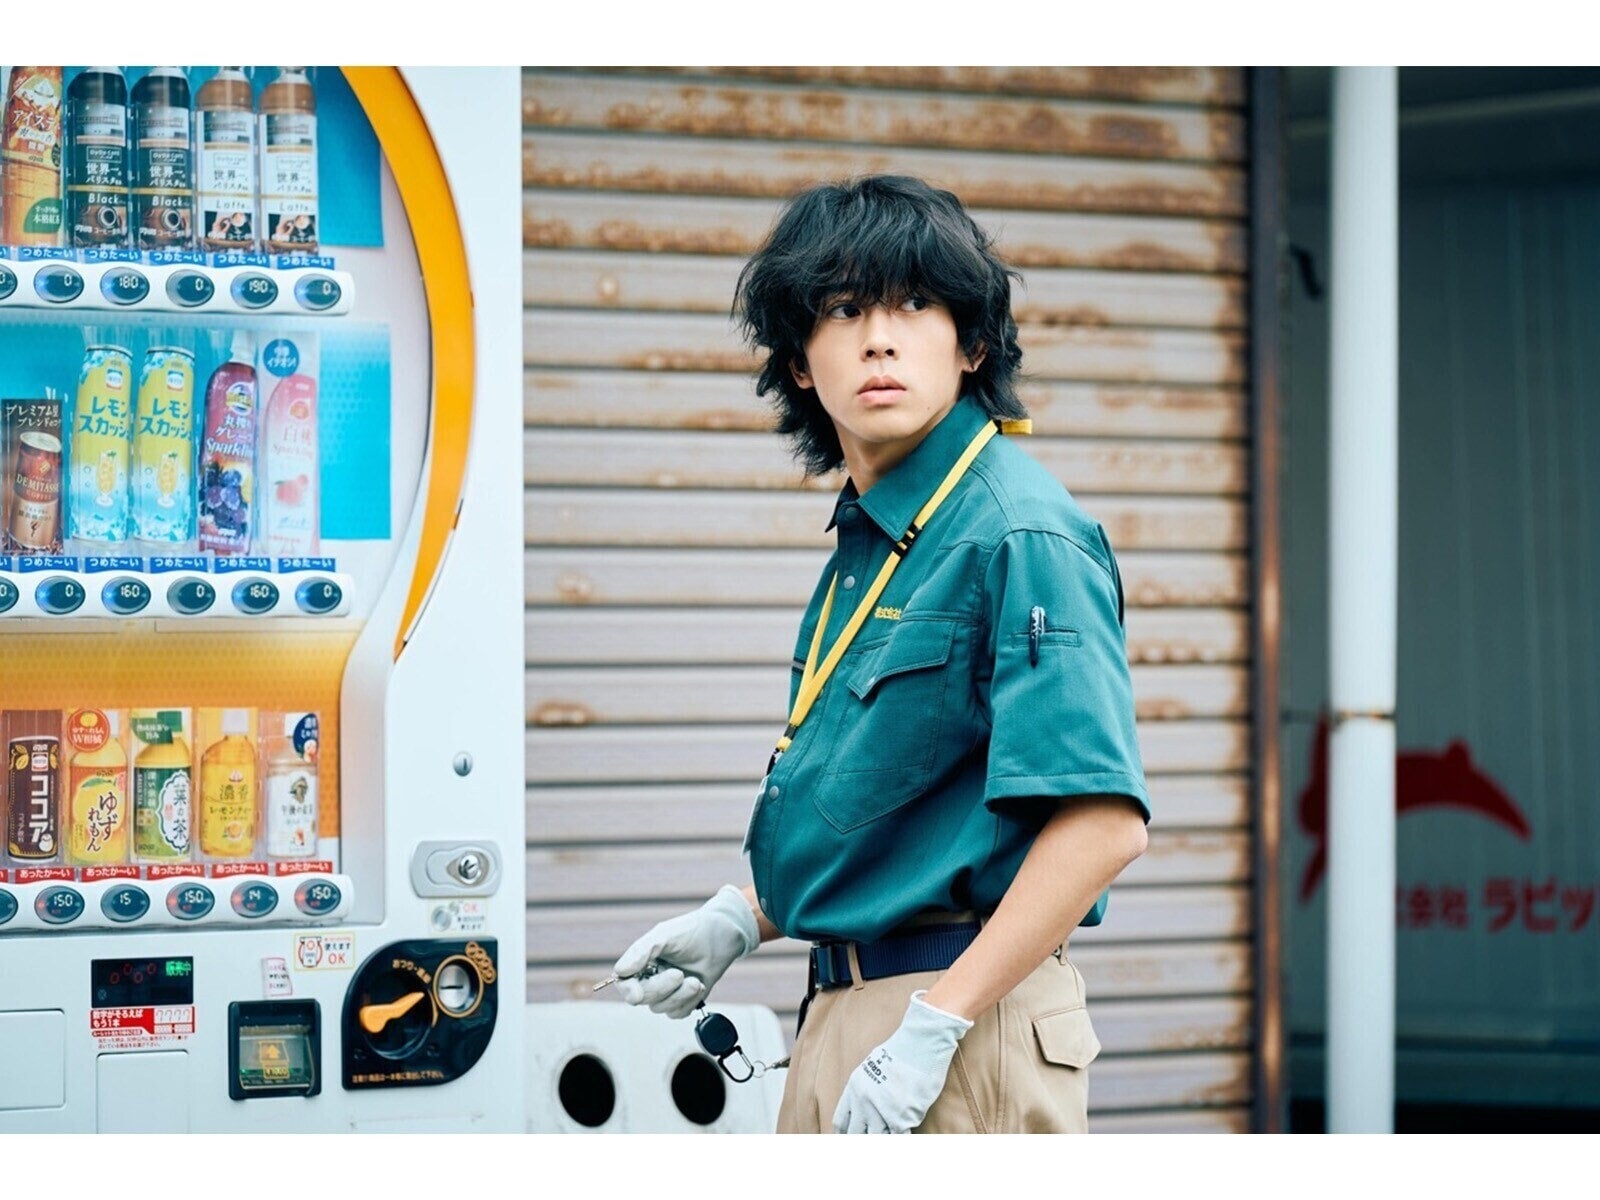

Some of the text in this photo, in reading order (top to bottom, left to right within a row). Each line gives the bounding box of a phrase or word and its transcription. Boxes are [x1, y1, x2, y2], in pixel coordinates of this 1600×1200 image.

[88, 193, 119, 204] Black
[152, 196, 182, 206] Black
[216, 201, 245, 209] Latte
[280, 203, 308, 212] Latte
[23, 249, 74, 258] つめた〜い
[89, 250, 139, 260] つめた〜い
[154, 252, 203, 263] つめた〜い
[217, 254, 267, 265] つめた〜い
[281, 257, 332, 267] つめた〜い
[64, 273, 72, 287] 0
[119, 276, 139, 289] 180
[195, 278, 204, 291] 0
[249, 280, 269, 293] 190
[322, 282, 332, 295] 0
[92, 396, 127, 419] レモン
[153, 398, 189, 420] レモン
[24, 557, 74, 567] つめた〜い
[89, 557, 139, 567] つめた〜い
[155, 557, 204, 567] つめた〜い
[218, 557, 268, 568] つめた〜い
[282, 557, 332, 568] つめた〜い
[65, 584, 74, 597] 0
[120, 584, 140, 598] 160
[196, 584, 205, 598] 0
[250, 585, 270, 598] 160
[323, 584, 332, 598] 0
[29, 775, 48, 843] ココア
[100, 791, 118, 841] ゆず
[87, 807, 102, 852] れもん
[86, 866, 136, 876] あったか〜い
[152, 865, 201, 875] あったか〜い
[216, 863, 266, 874] あったか〜い
[280, 862, 329, 872] あったか〜い
[20, 868, 70, 878] あったか〜い
[120, 892, 131, 905] 15
[184, 890, 204, 903] 150
[312, 887, 331, 900] 150
[54, 894, 73, 907] 150
[328, 953, 346, 965] OK
[93, 1019, 120, 1029] もう1本
